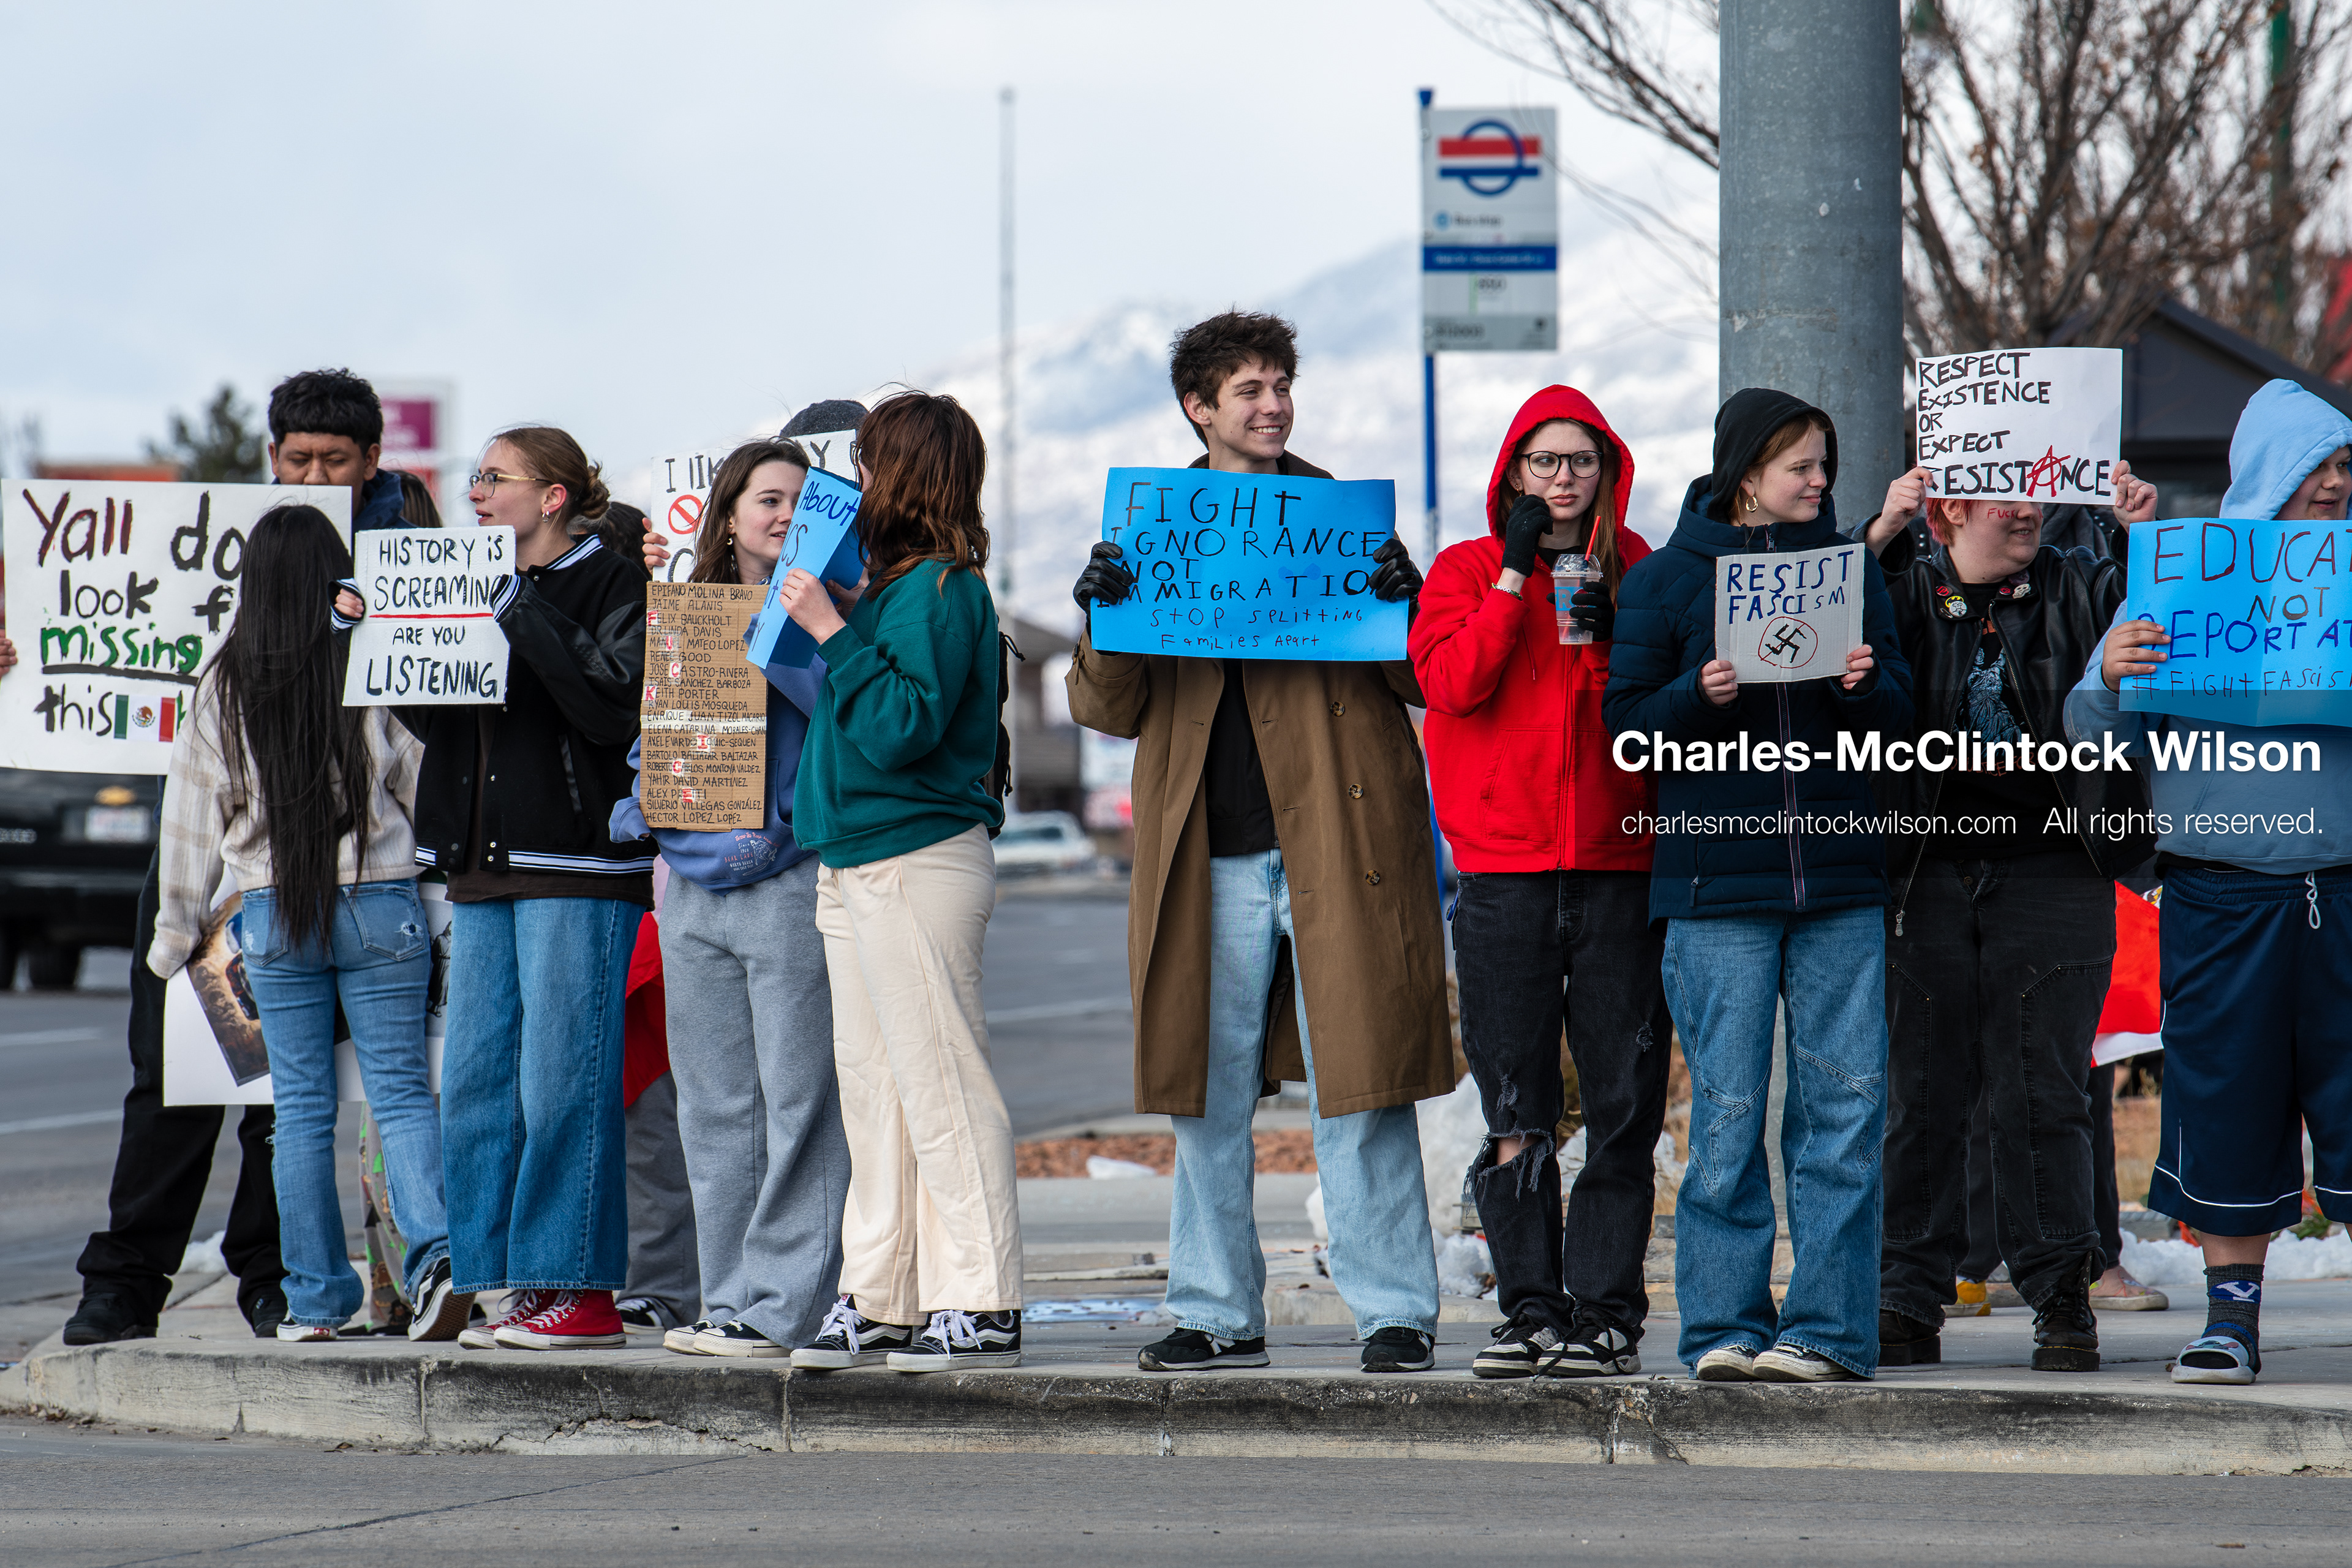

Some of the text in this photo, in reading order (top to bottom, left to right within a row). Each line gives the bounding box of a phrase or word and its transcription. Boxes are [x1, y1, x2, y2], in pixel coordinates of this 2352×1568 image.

[1919, 352, 2030, 388] RESPECT
[1918, 380, 2051, 412] EXISTENCE
[1919, 412, 1943, 432] OR
[1919, 430, 2011, 461] EXPECT
[665, 458, 676, 493] I
[1921, 445, 2111, 498] RESISTANCE
[1126, 482, 1301, 528] FIGHT
[1987, 508, 2015, 519] FUCK
[23, 488, 133, 567] Yall
[1110, 526, 1387, 559] IGNORANCE
[380, 535, 475, 573] HISTORY
[1120, 557, 1199, 584] NOT
[1727, 550, 1854, 594] RESIST
[60, 570, 158, 619] look
[652, 585, 686, 597] EPIFANO
[688, 586, 724, 598] MOLINA
[730, 587, 753, 601] BRAVO
[1096, 570, 1375, 608] MMIGRATIO
[652, 598, 723, 611] JAIME ALANIS
[2247, 587, 2330, 623] NOT
[647, 610, 732, 627] FELIX BAUCKHOLT
[393, 625, 466, 647] ARE YOU
[693, 627, 722, 638] DAVIS
[40, 622, 203, 674] missing
[687, 639, 716, 650] MATEO
[718, 640, 745, 651] LOPEZ
[650, 650, 711, 663] RENEE GOOD
[366, 655, 498, 699] LISTENING
[649, 663, 748, 679] JOSE CASTRO-RIVERA
[675, 677, 714, 688] SANCHEZ
[717, 679, 751, 689] BARBOZA
[645, 685, 719, 701] KEITH PORTER
[34, 684, 113, 736] this
[648, 699, 748, 712] RYAN LOUIS MOSQUEDA
[647, 710, 765, 723] ENRIQUE JUAN TIZOL MACARIO
[648, 724, 766, 735] ELENA CATARINA MORALES-CHAN
[647, 736, 665, 747] AXEL
[647, 750, 758, 761] BARTOLO BALTAZAR BALTAZAR
[673, 761, 704, 773] CARLOS
[706, 764, 735, 774] MONTOYA
[735, 764, 761, 774] VALDEZ
[647, 773, 748, 787] YAHIR DAVID MARTINEZ
[647, 788, 668, 799] ALEX
[647, 800, 677, 810] SILVERIO
[682, 801, 725, 811] VILLEGAS
[646, 812, 679, 823] HECTOR
[684, 812, 714, 823] LOPEZ
